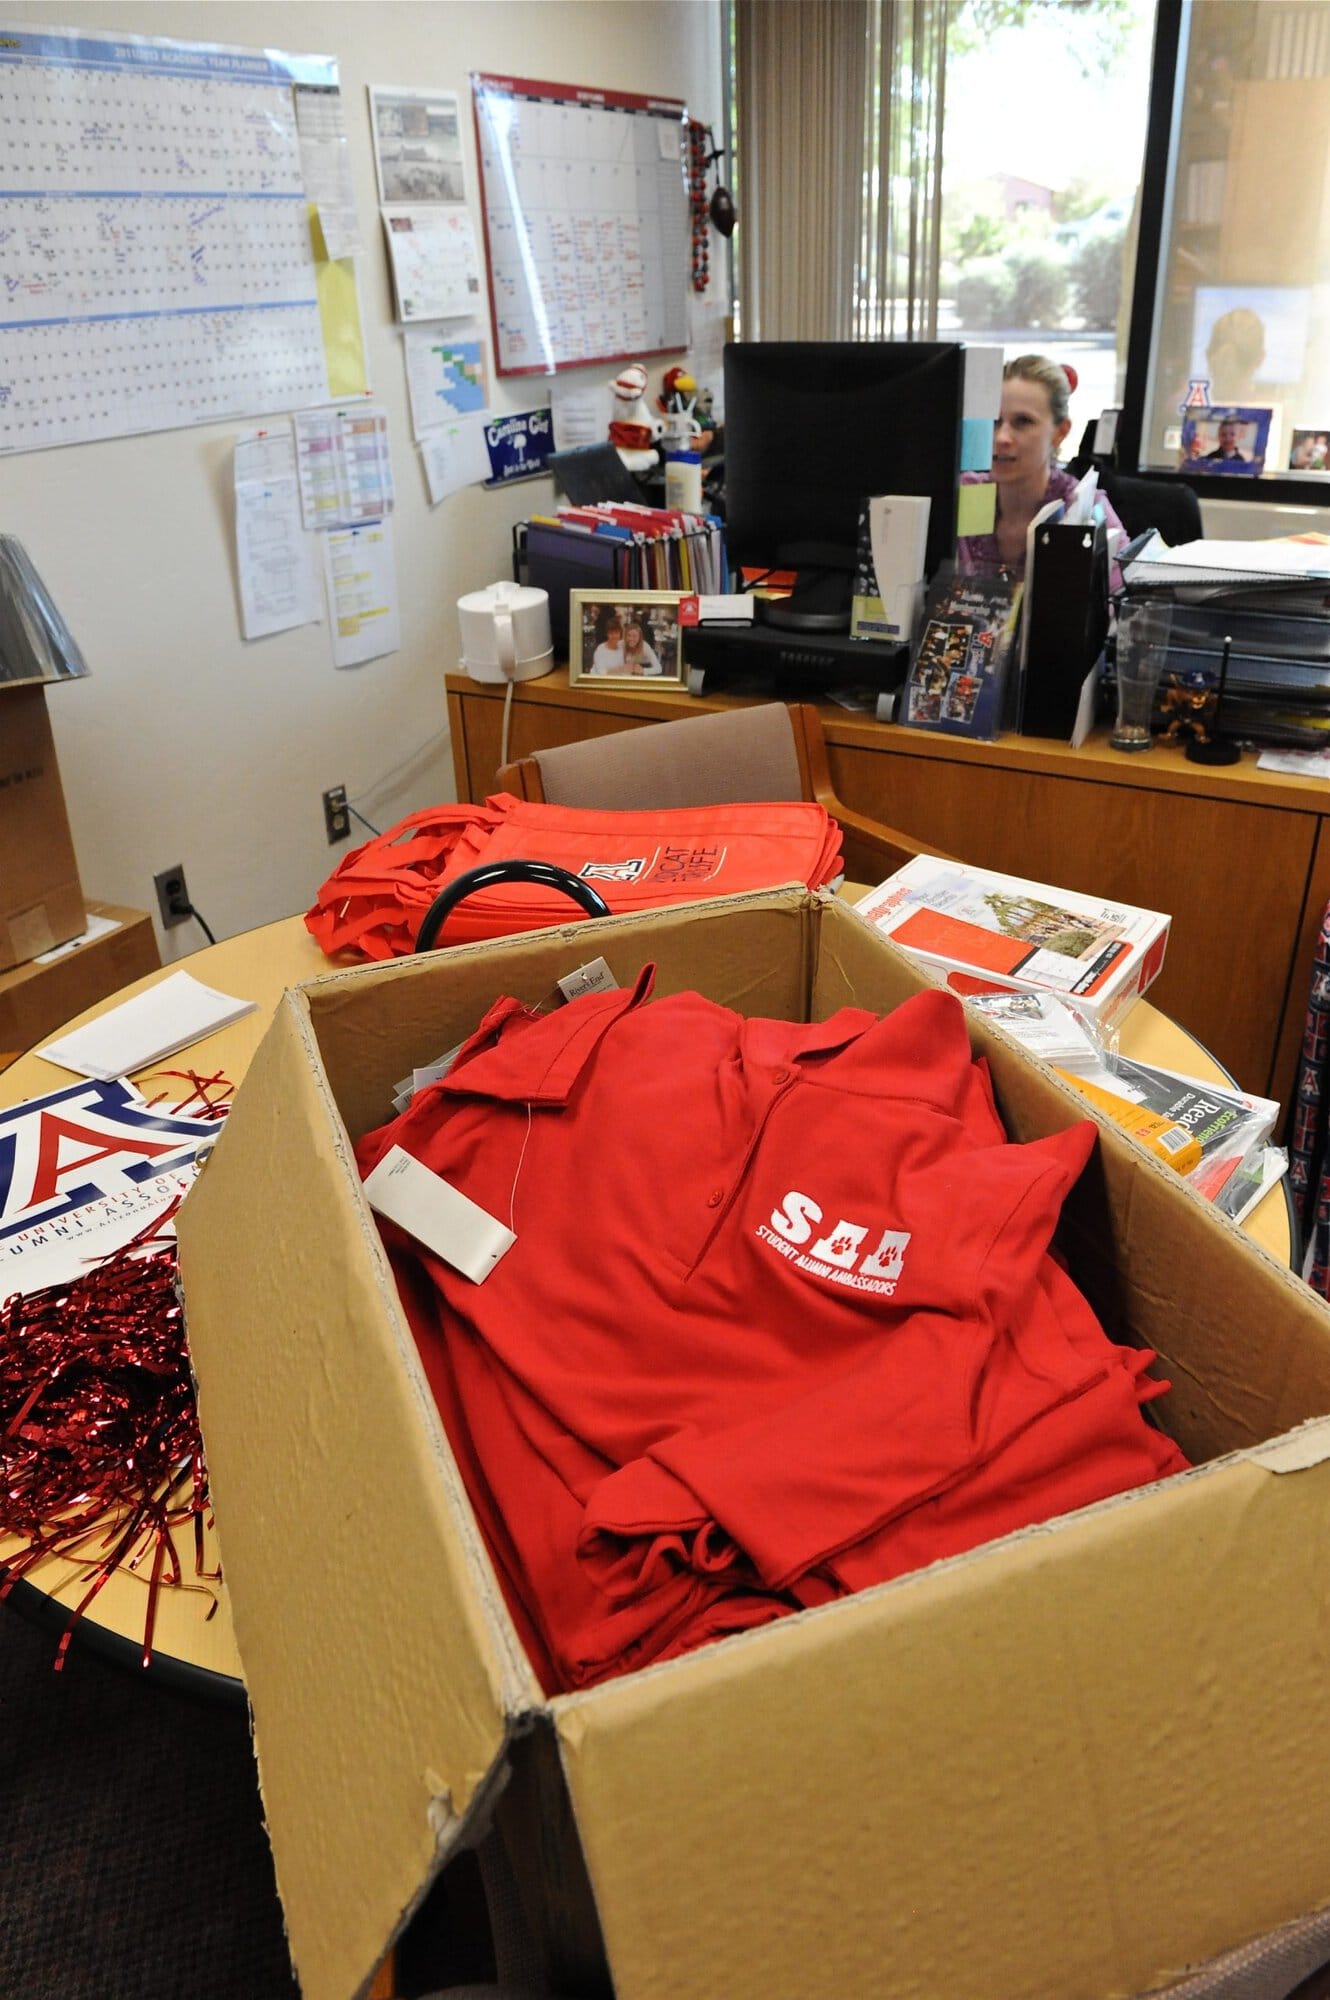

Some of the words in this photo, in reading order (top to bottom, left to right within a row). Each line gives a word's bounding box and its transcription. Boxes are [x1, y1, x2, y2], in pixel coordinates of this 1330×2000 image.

[1175, 1099, 1221, 1136] Read
[9, 1220, 84, 1255] UMNI
[18, 1186, 142, 1241] UNIVERSITY
[155, 1173, 176, 1185] OF
[770, 1190, 912, 1281] SAA
[755, 1224, 800, 1262] STUDENT
[795, 1255, 833, 1279] ALUMNI
[829, 1269, 897, 1297] AMBASSADORS
